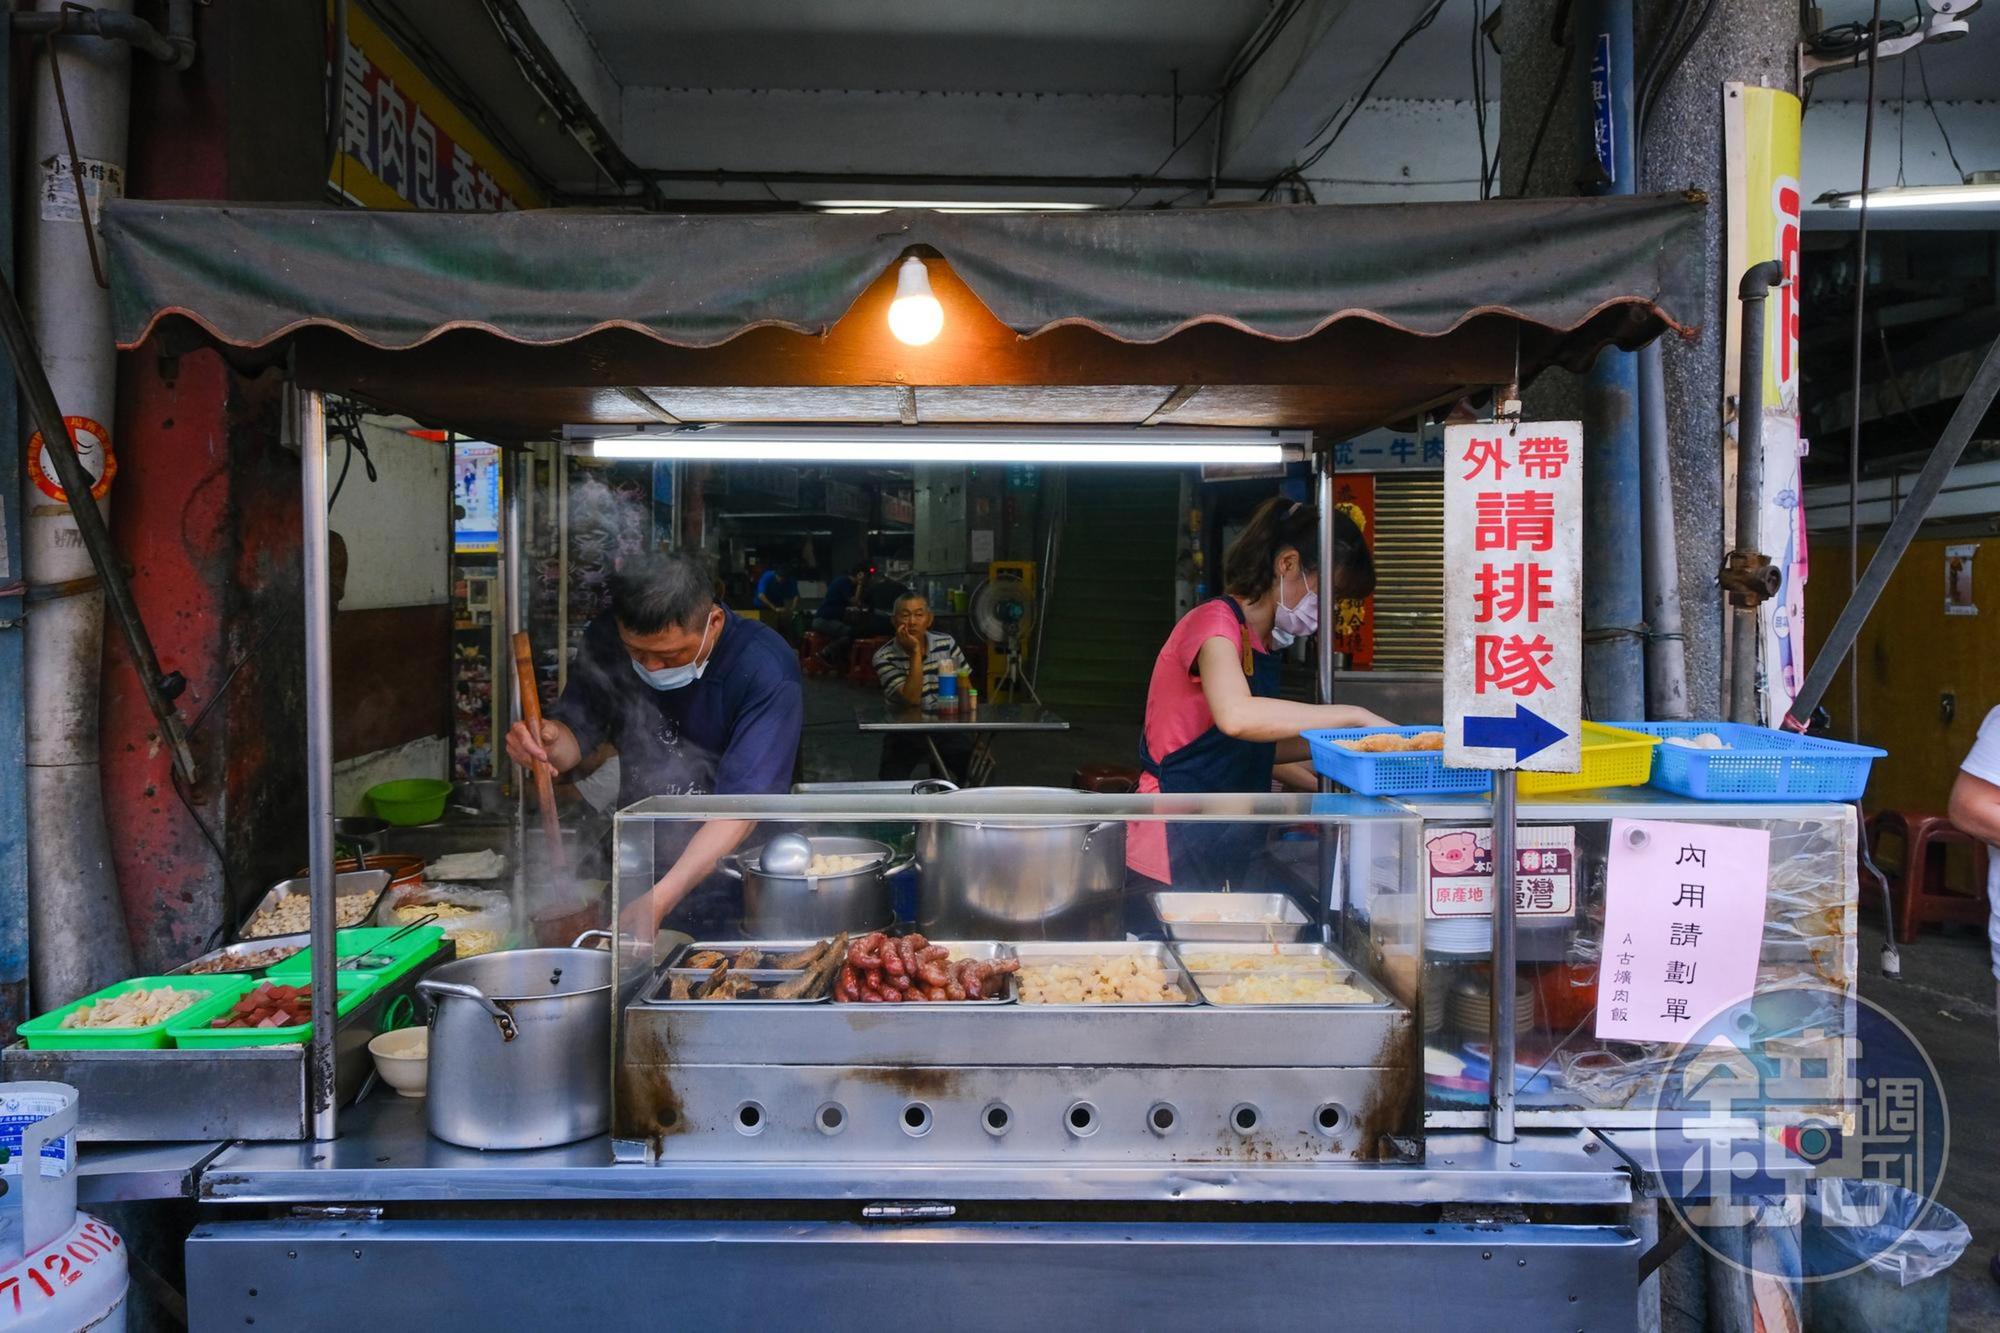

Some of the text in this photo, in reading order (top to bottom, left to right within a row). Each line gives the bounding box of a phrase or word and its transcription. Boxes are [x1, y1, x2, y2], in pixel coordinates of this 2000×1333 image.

[1462, 436, 1569, 481] 外帶
[1473, 490, 1556, 697] 請排隊
[1436, 887, 1484, 903] 原產地
[1660, 843, 1706, 1023] 內用請劃單
